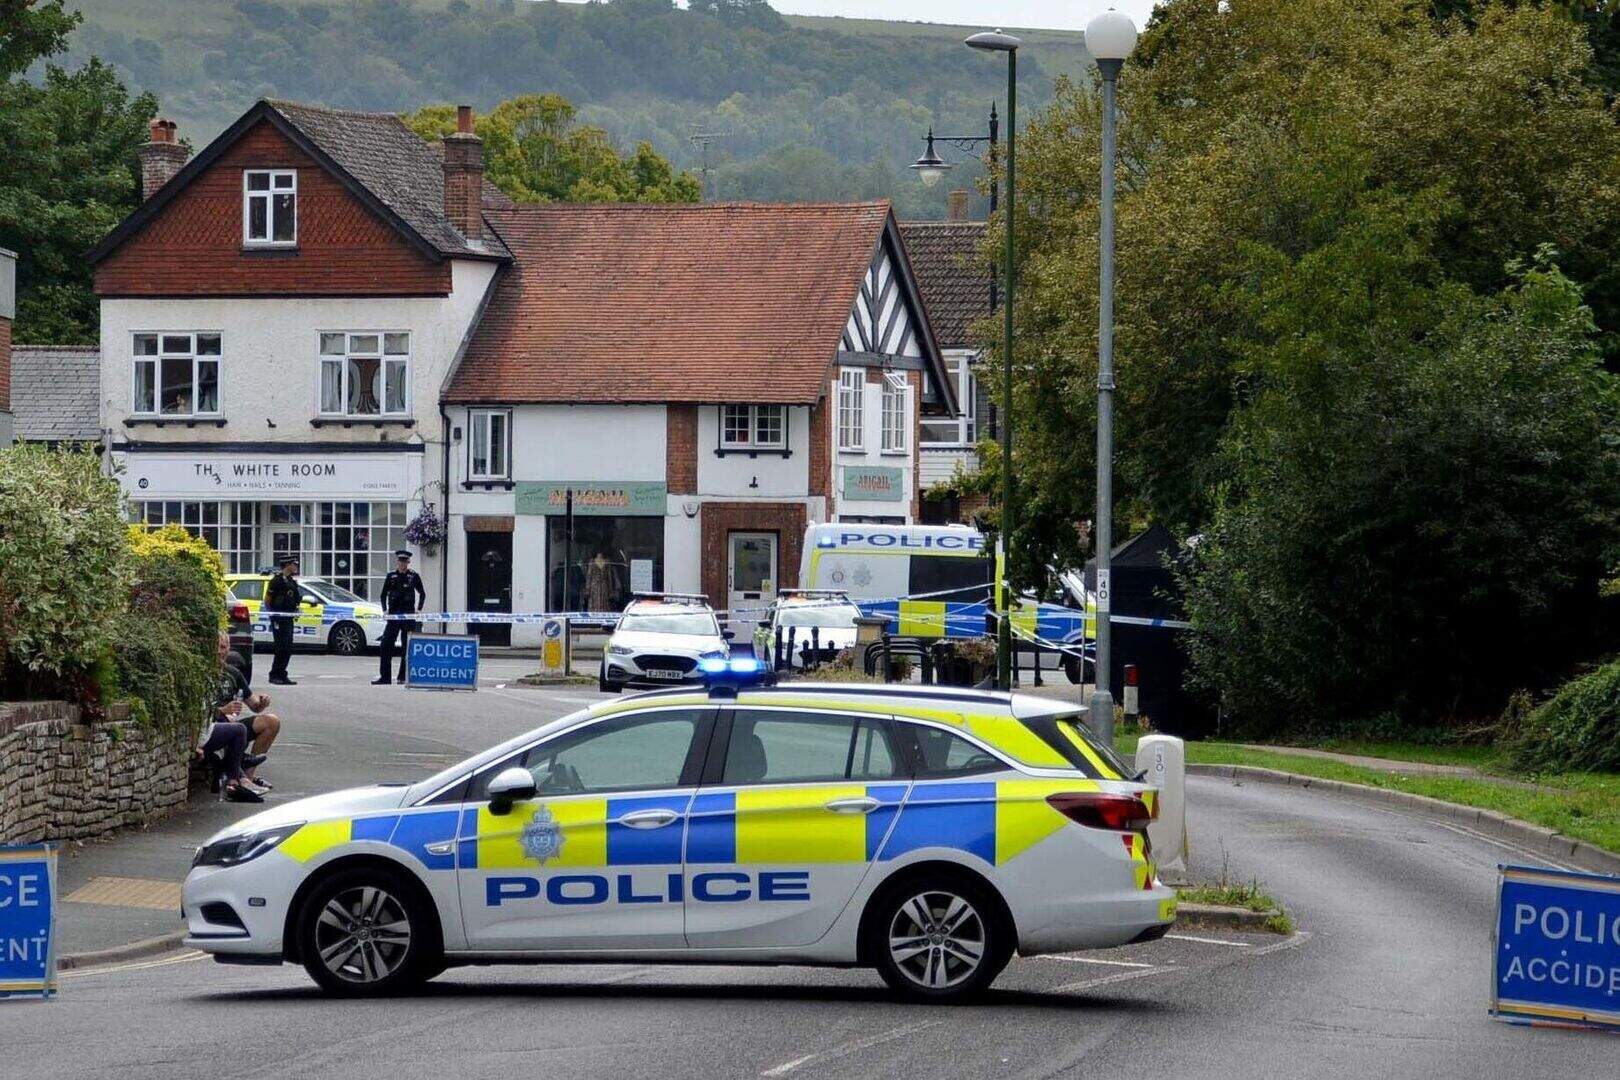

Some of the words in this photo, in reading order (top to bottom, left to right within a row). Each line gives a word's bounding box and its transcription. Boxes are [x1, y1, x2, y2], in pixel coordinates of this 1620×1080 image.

[233, 464, 280, 476] WHITE
[291, 464, 336, 476] ROOM
[1100, 581, 1107, 599] 40
[413, 643, 472, 658] POLICE
[410, 667, 475, 679] ACCIDENT
[1155, 754, 1163, 772] 30
[486, 872, 810, 906] POLICE
